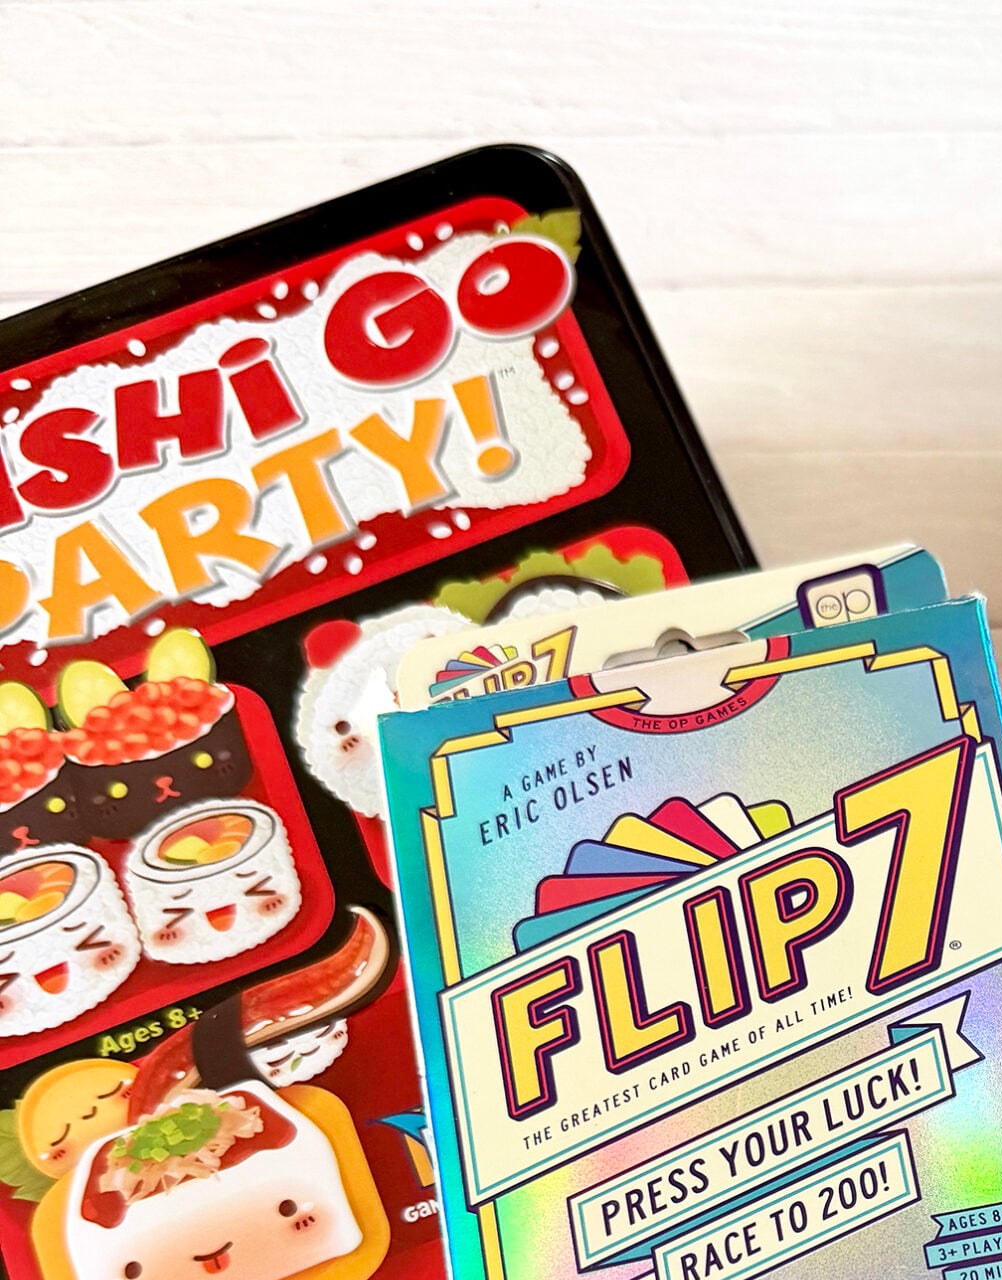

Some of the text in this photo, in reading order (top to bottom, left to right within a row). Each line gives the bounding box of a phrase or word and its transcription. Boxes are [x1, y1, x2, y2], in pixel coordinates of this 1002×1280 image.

[323, 239, 571, 387] GO
[633, 697, 748, 730] THE OP GAMES
[479, 756, 633, 846] ERIC OLSEN
[503, 746, 597, 801] A GAME BY
[491, 847, 854, 1120] FLIP
[100, 1003, 205, 1059] Ages 8+
[523, 986, 854, 1150] THE GREATEST CARD GAME OF ALL TIME!
[601, 1057, 922, 1236] PRESS YOUR LUCK!
[769, 1202, 808, 1242] TO
[818, 1160, 890, 1220] 200!
[948, 1212, 987, 1232] AGES
[938, 1245, 958, 1261] 3+
